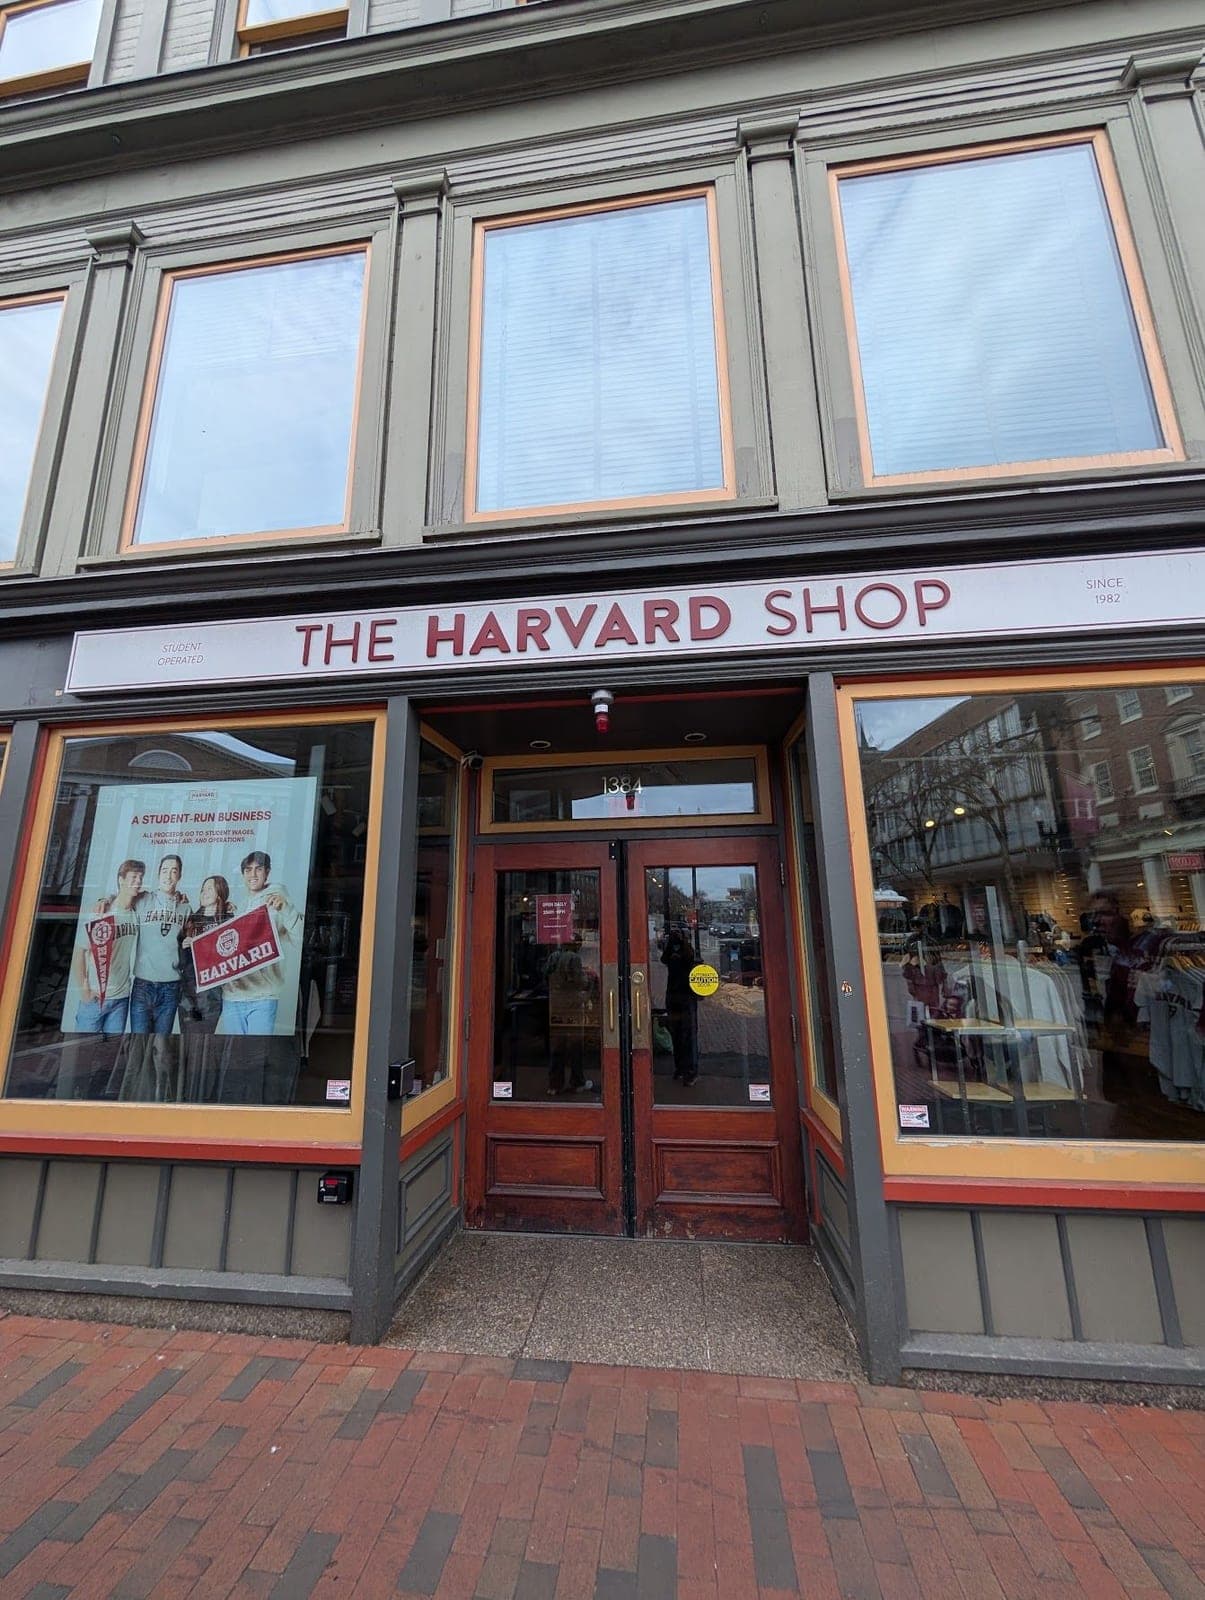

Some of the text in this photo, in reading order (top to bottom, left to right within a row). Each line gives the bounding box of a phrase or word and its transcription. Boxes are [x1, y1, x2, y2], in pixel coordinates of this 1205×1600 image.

[1086, 577, 1124, 590] SINCE
[1095, 593, 1121, 604] 1982
[295, 578, 951, 666] THE HARVARD SHOP
[162, 642, 202, 653] STUDENT
[157, 655, 204, 666] OPERATED
[601, 776, 643, 794] 1384
[131, 810, 273, 825] A STUDENT-RUN BUSINESS
[142, 831, 153, 839] ALL
[205, 829, 232, 837] STUDENT
[199, 941, 273, 984] HARVARD
